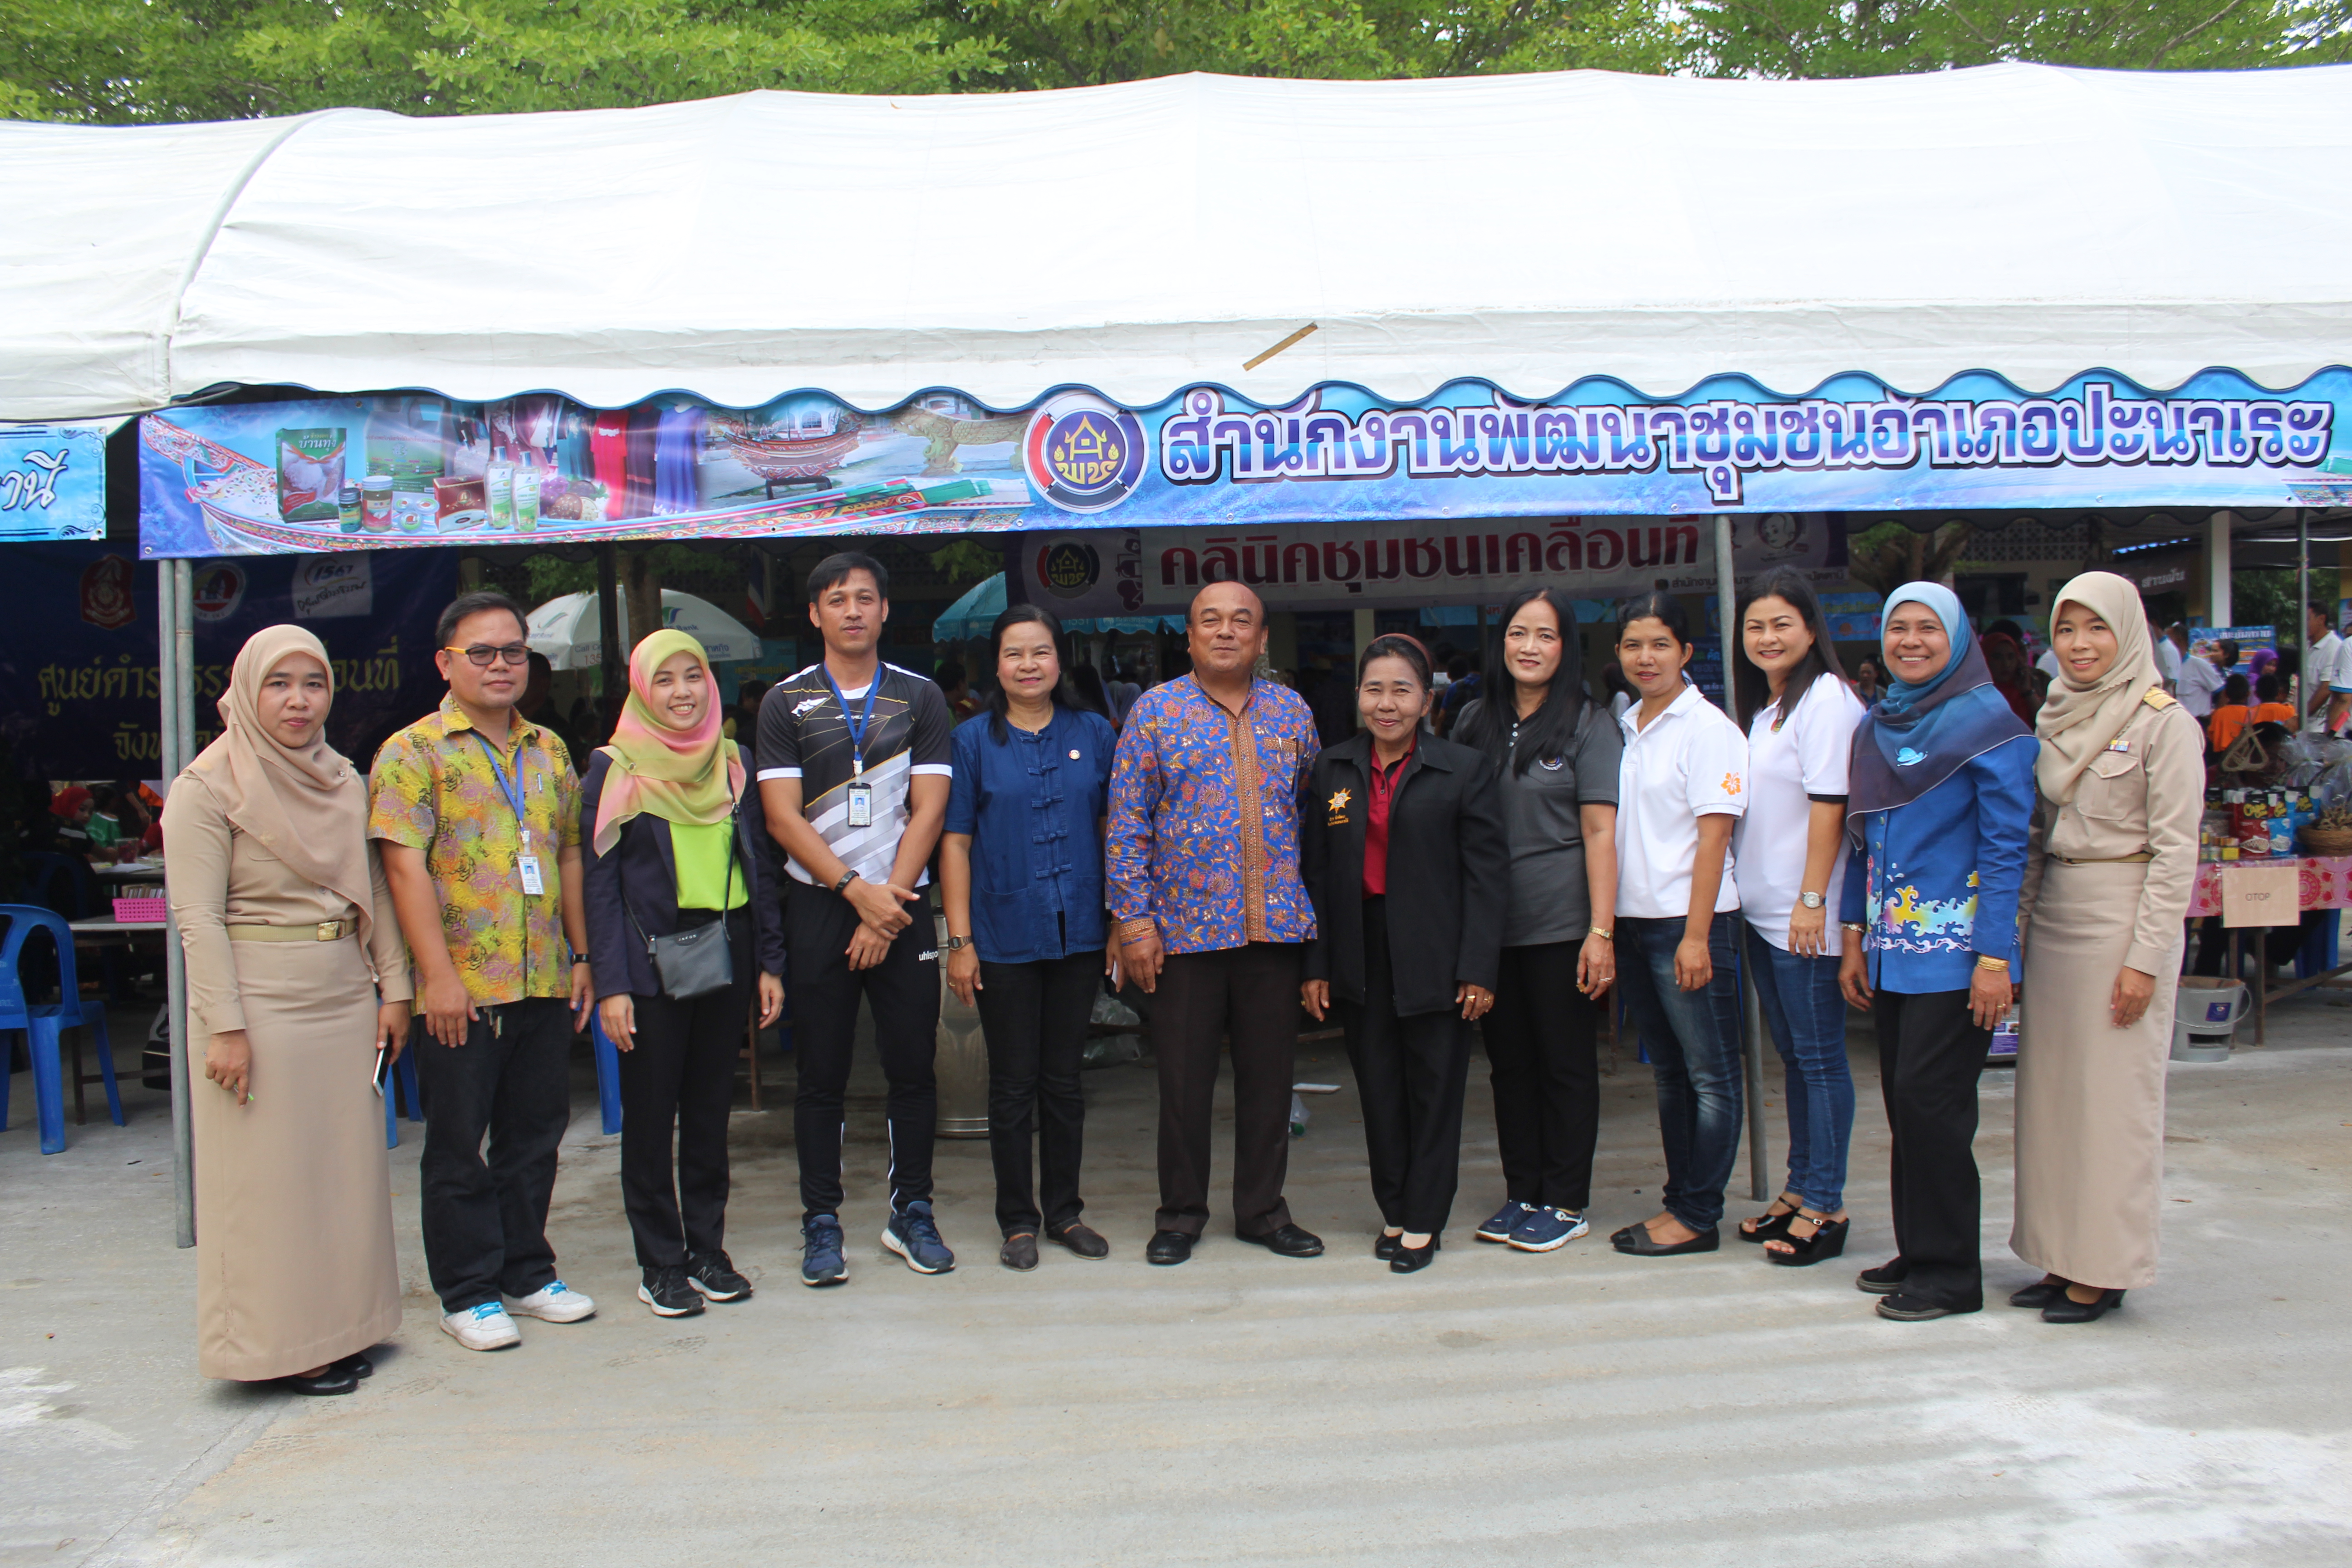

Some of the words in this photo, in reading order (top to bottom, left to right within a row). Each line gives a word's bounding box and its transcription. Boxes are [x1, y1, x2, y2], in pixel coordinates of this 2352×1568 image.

[299, 435, 337, 452] บ้านทุ่ง
[0, 449, 69, 511] านี
[1161, 516, 1700, 593] คลินิคชุมชนเคลือนที
[314, 565, 354, 583] 1567
[584, 653, 602, 665] 135
[2245, 892, 2271, 902] OTOP
[918, 951, 938, 961] uhlspo
